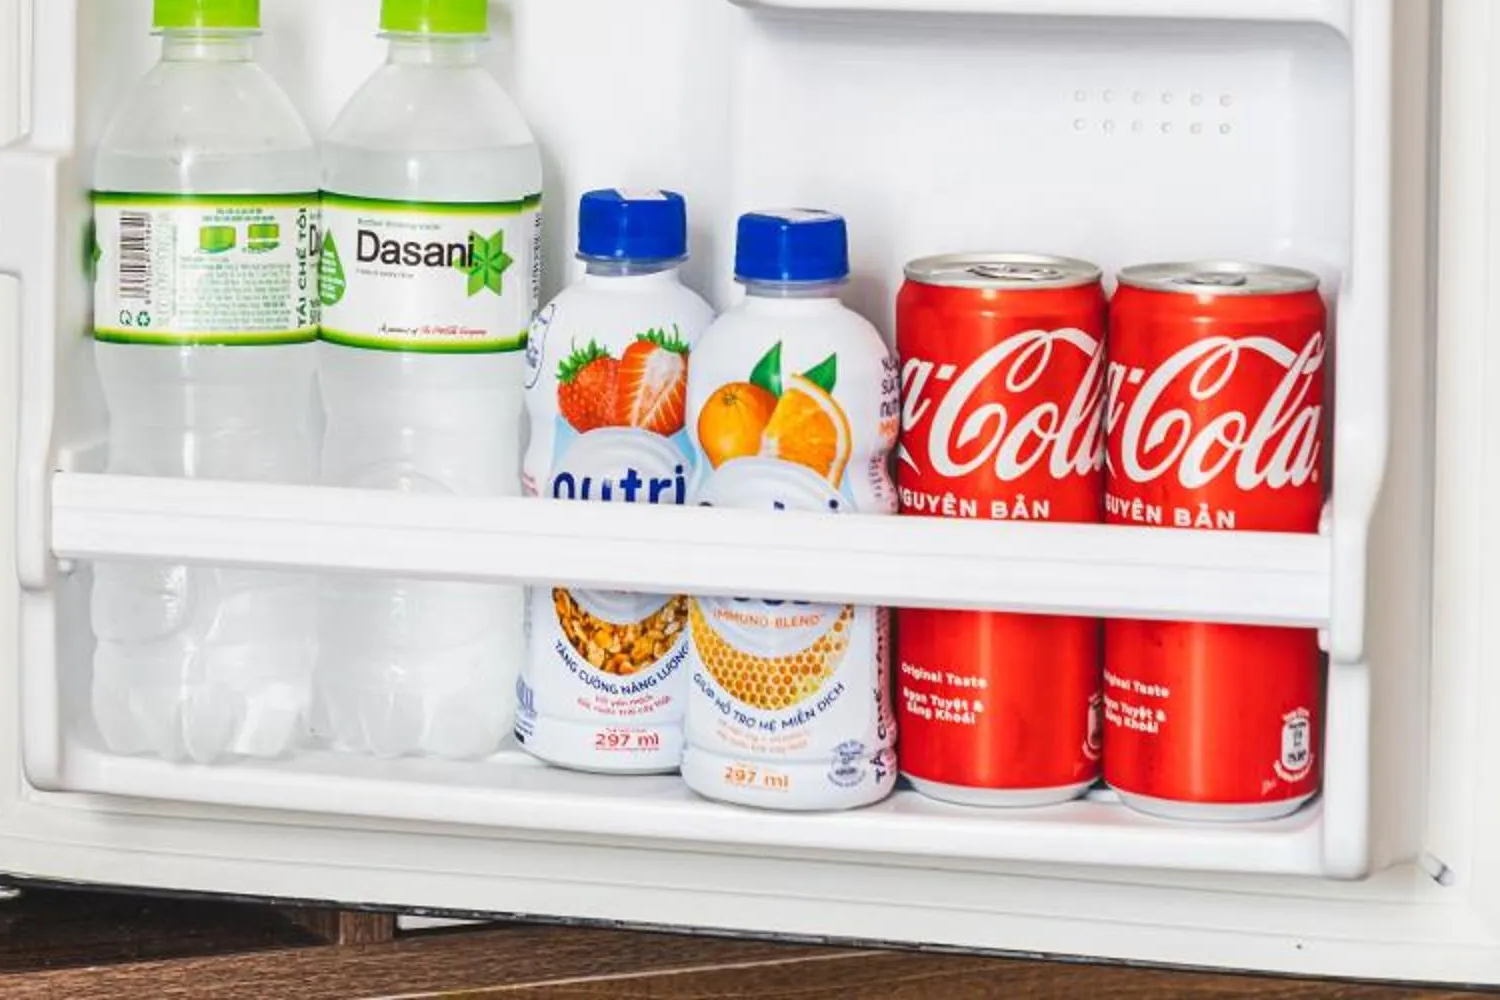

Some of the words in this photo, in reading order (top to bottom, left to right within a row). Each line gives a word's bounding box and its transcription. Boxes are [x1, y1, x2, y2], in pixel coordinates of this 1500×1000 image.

[357, 229, 476, 268] Dasani
[553, 464, 686, 505] nutri
[899, 485, 978, 518] GUYÊN
[991, 493, 1050, 520] BẢN
[1174, 502, 1236, 529] BẢN
[713, 607, 769, 628] IMMUNO
[902, 662, 943, 684] Original
[945, 672, 988, 689] Taste
[1132, 680, 1170, 699] Taste
[595, 733, 631, 747] 297
[637, 732, 660, 746] ml
[724, 766, 757, 784] 297
[763, 770, 790, 789] ml
